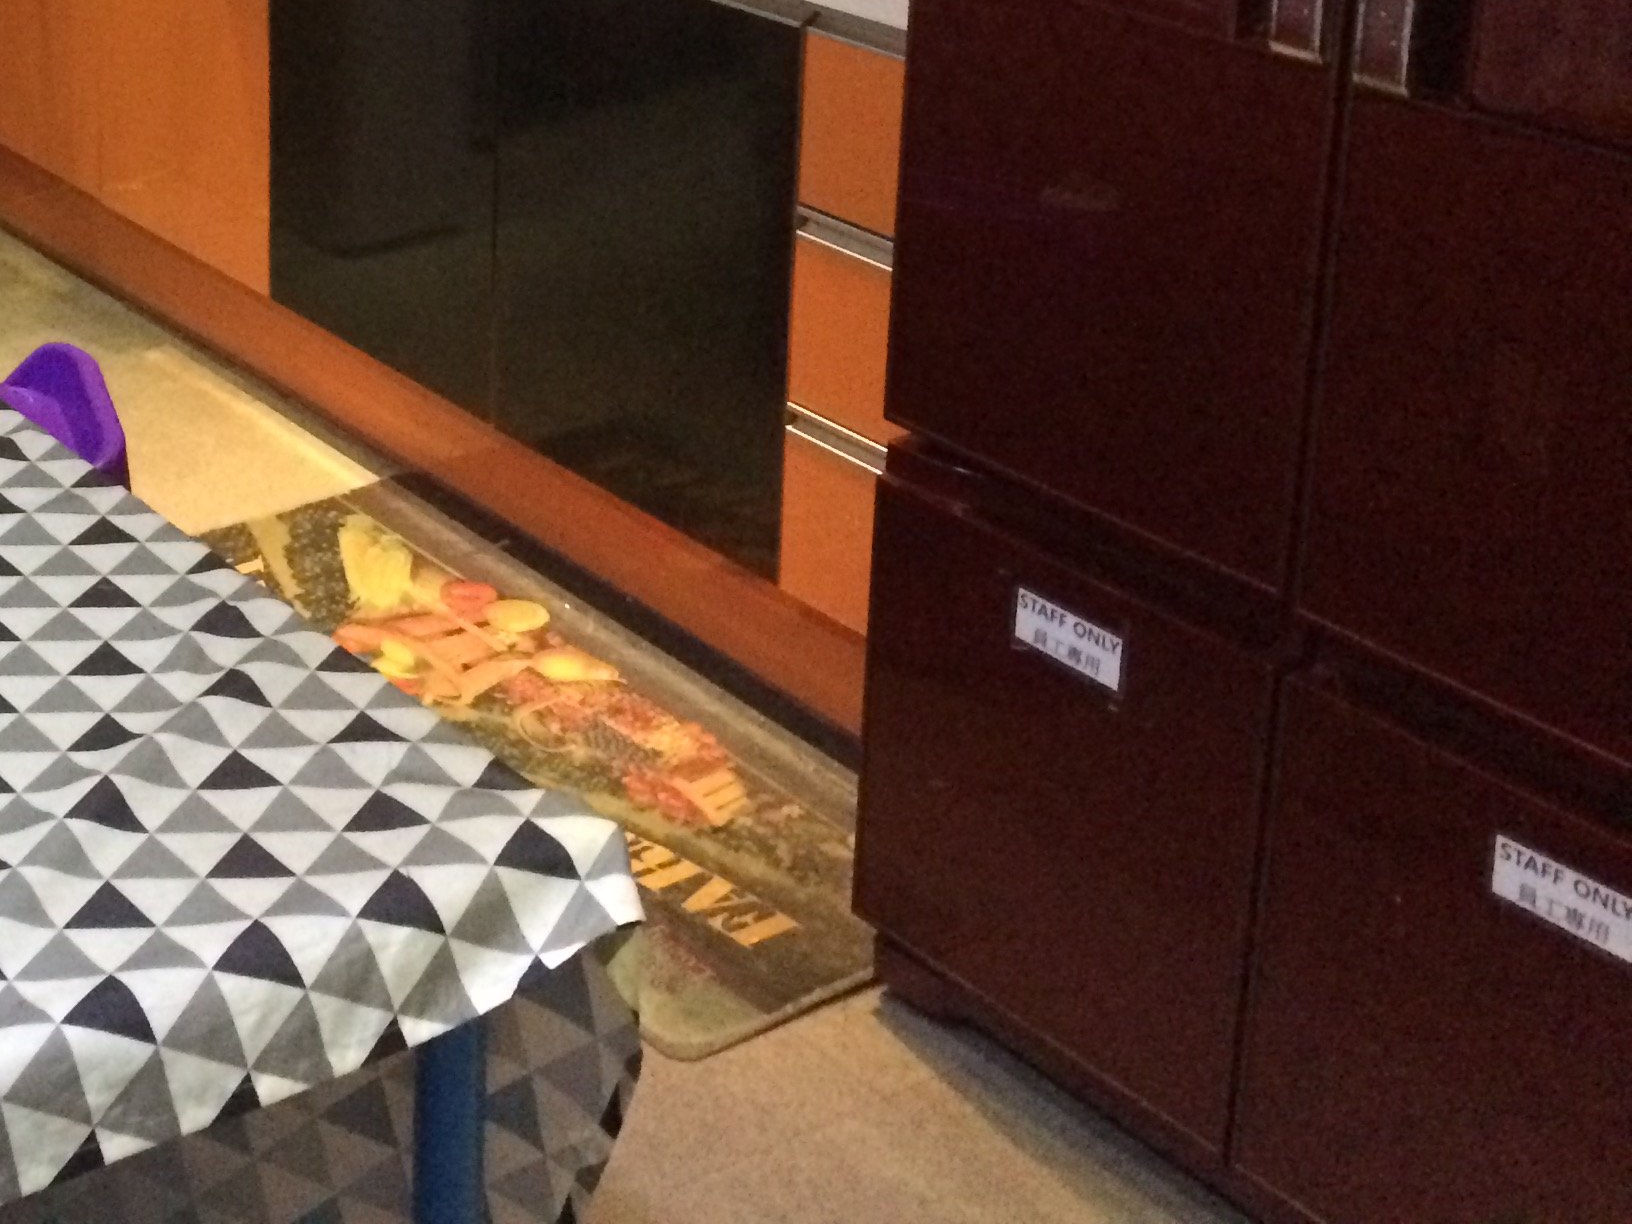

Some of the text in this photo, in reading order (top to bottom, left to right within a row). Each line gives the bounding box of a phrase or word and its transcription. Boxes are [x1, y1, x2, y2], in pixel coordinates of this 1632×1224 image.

[1020, 593, 1120, 655] STAFF ONLY
[1500, 842, 1565, 885] STAFF
